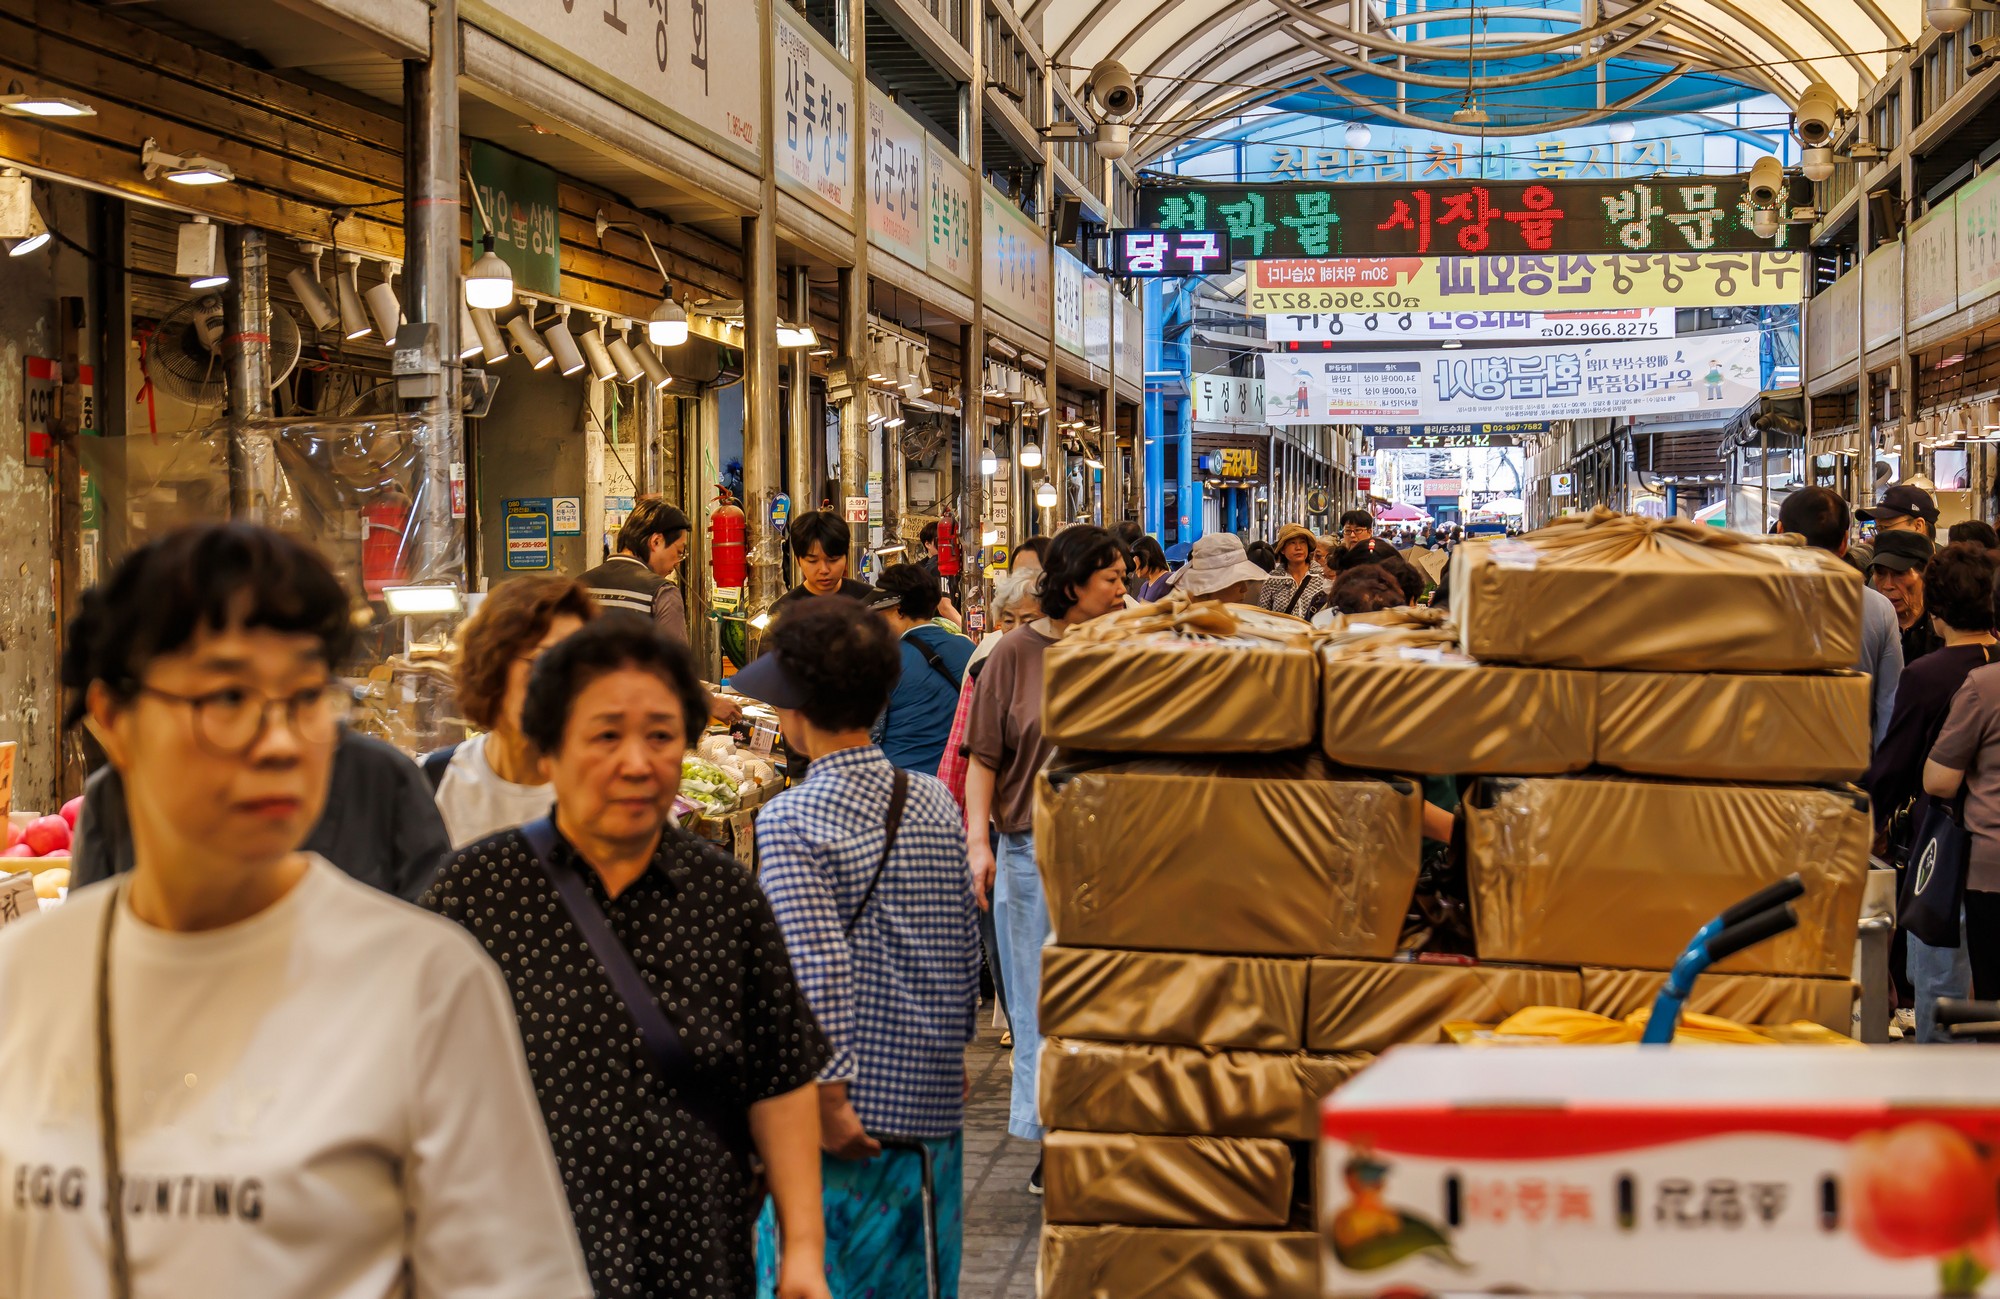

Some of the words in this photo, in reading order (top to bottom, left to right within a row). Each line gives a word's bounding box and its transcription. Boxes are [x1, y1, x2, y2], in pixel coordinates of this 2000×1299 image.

[785, 57, 847, 186] 삼동청과
[871, 127, 919, 228] 장군상회
[531, 202, 555, 257] 상회
[932, 173, 969, 263] 칠복청과
[1377, 185, 1564, 253] 시장을
[1124, 233, 1220, 271] 당구
[1554, 322, 1658, 337] 02.966.8275
[1204, 381, 1263, 415] 두성상사
[1374, 425, 1390, 435] 척추
[1395, 425, 1411, 435] 관절
[13, 1163, 87, 1211] EGG
[102, 1172, 265, 1224] UNTING
